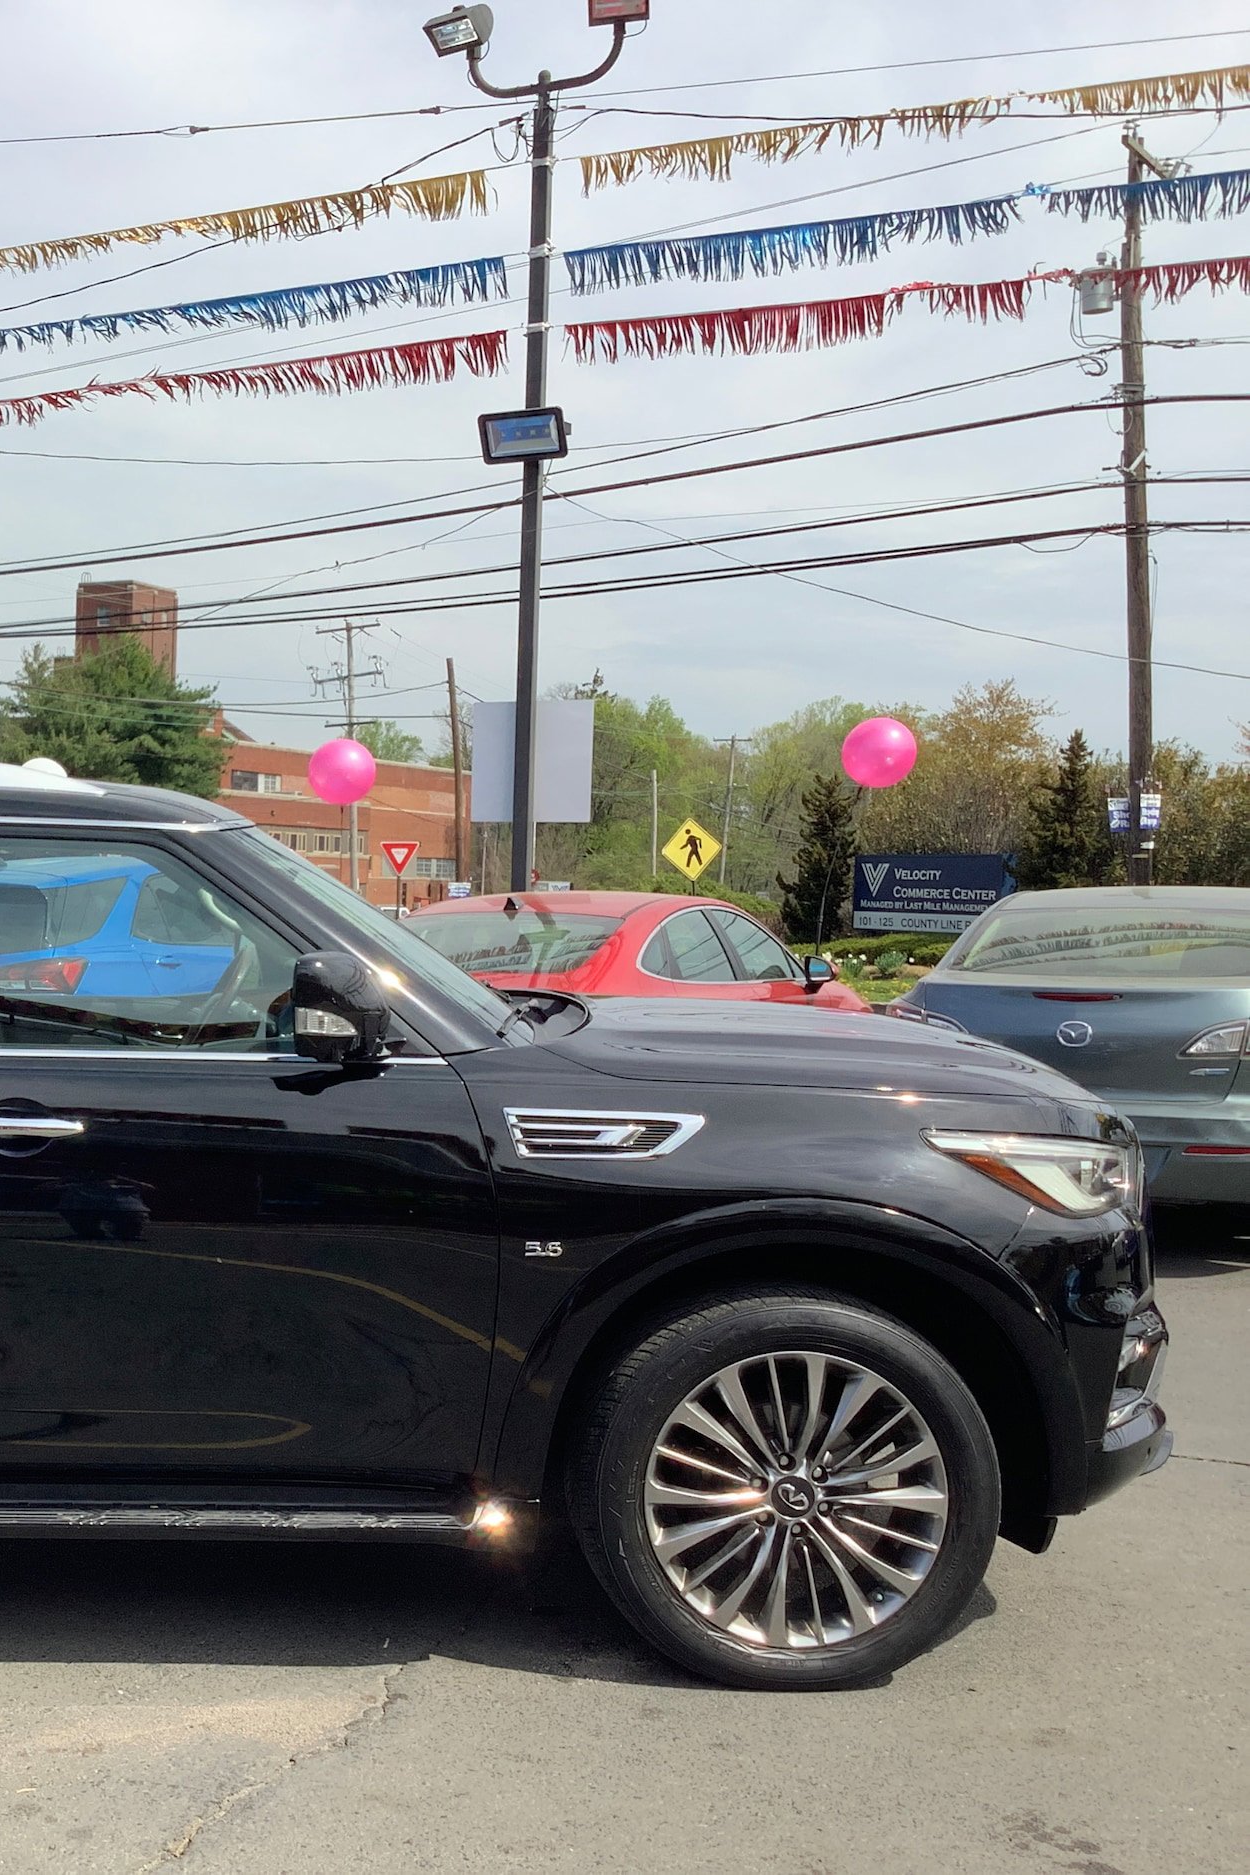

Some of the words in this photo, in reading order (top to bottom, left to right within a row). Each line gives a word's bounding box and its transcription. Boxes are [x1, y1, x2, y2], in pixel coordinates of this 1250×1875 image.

[894, 868, 942, 880] VELOCITY
[893, 886, 950, 899] COMMERCE
[952, 887, 996, 900] CENTER
[860, 899, 894, 909] MANAGED
[904, 901, 923, 910] LAST
[901, 918, 938, 929] COUNTY
[941, 919, 963, 930] LINE
